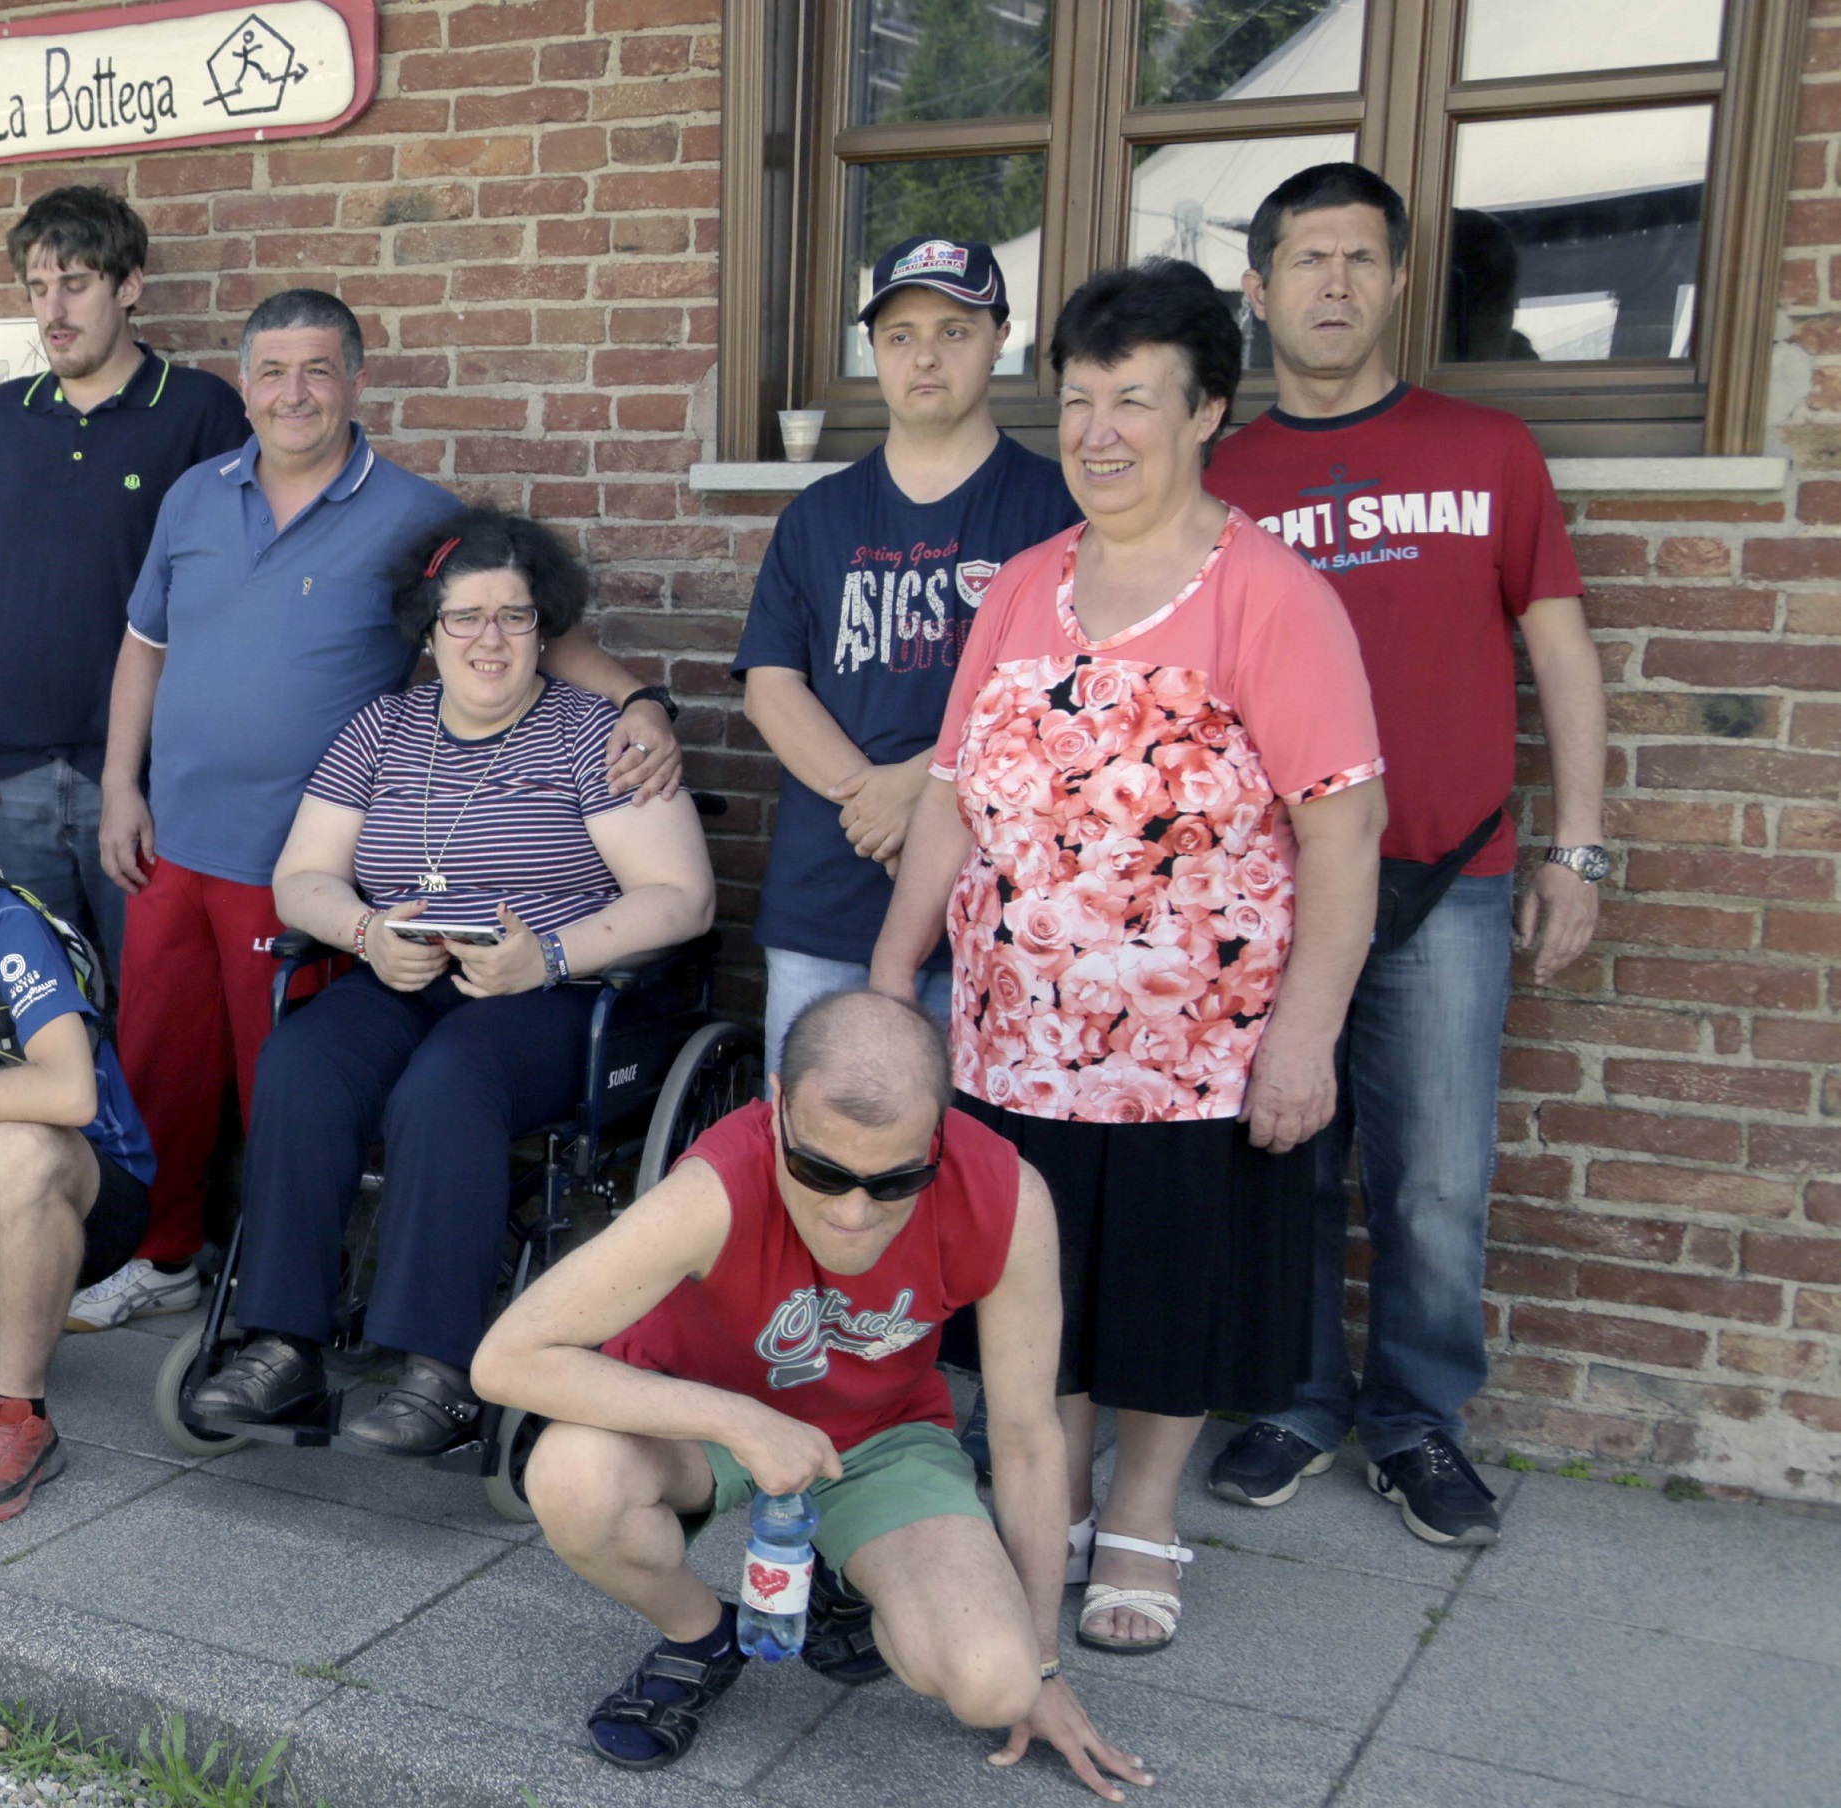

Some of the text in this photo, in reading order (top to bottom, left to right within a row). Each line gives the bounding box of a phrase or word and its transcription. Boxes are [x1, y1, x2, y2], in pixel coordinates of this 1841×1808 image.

[45, 47, 178, 135] Bottega
[910, 537, 958, 566] Goods
[1332, 546, 1419, 568] SAILING
[834, 568, 948, 674] ASICS
